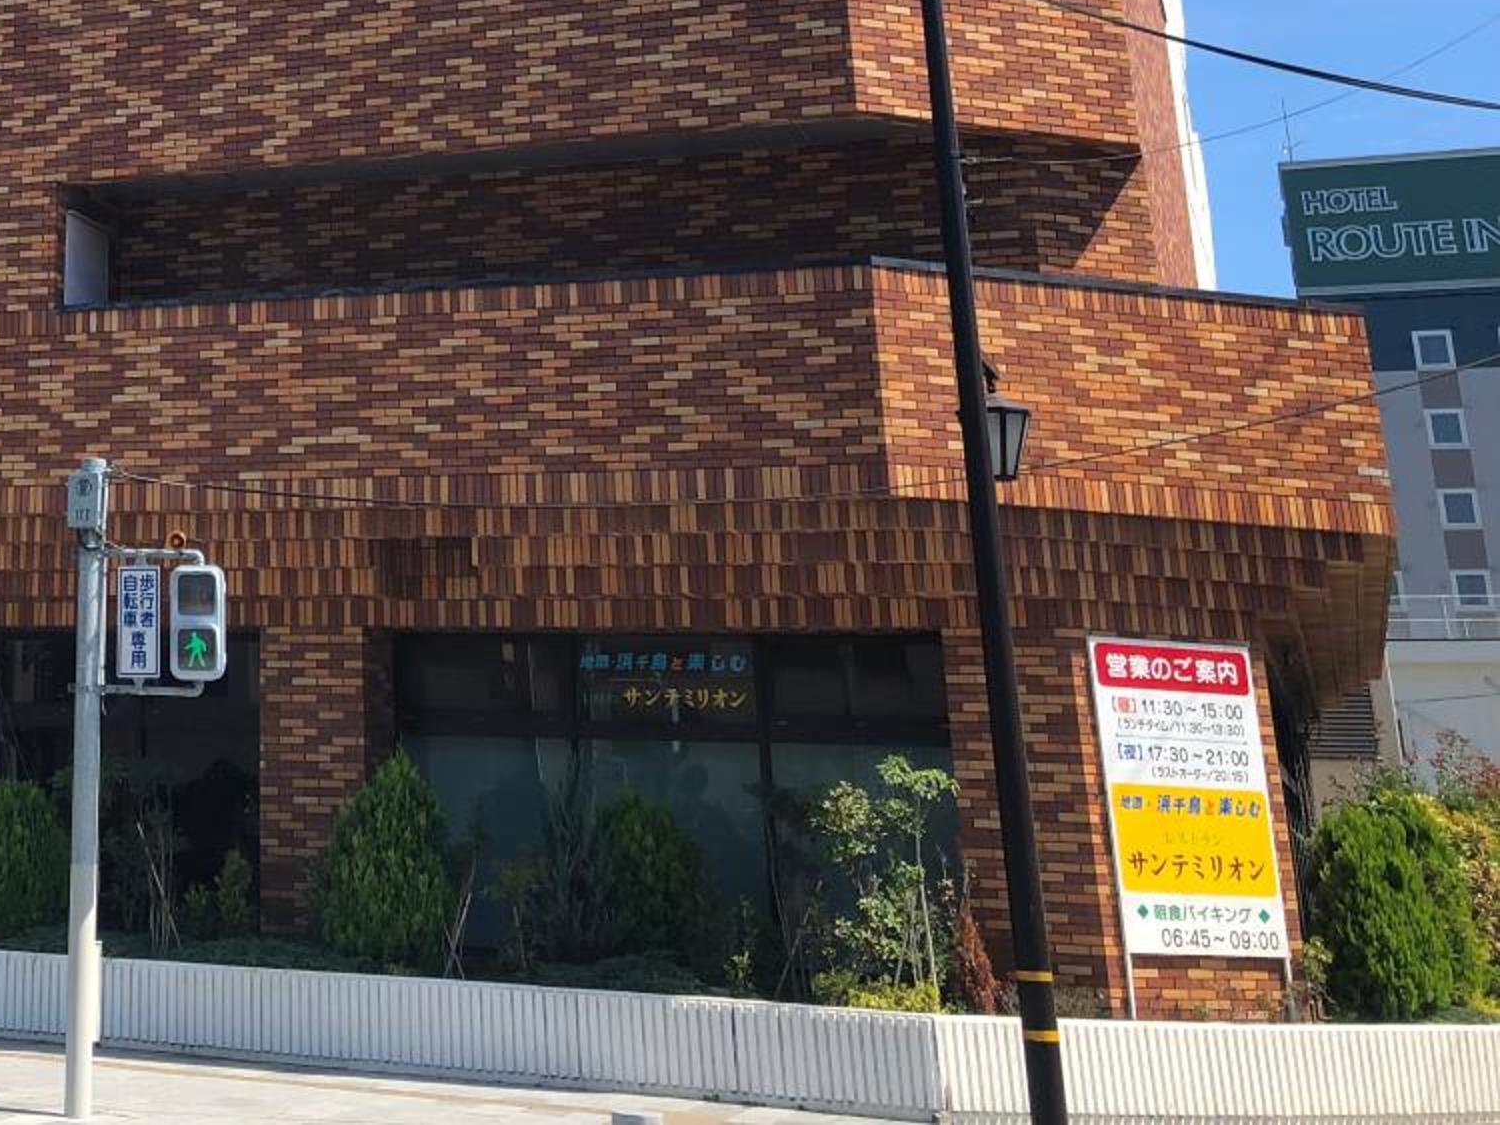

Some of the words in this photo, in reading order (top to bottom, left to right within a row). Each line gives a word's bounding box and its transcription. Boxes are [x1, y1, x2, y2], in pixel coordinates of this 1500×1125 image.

[1301, 186, 1398, 216] HOTEL
[1306, 220, 1458, 262] ROUTE
[123, 574, 138, 627] 自転車
[139, 574, 155, 627] 歩行者
[1106, 652, 1239, 687] 営業のご案内
[1128, 850, 1265, 882] サンテミリオン
